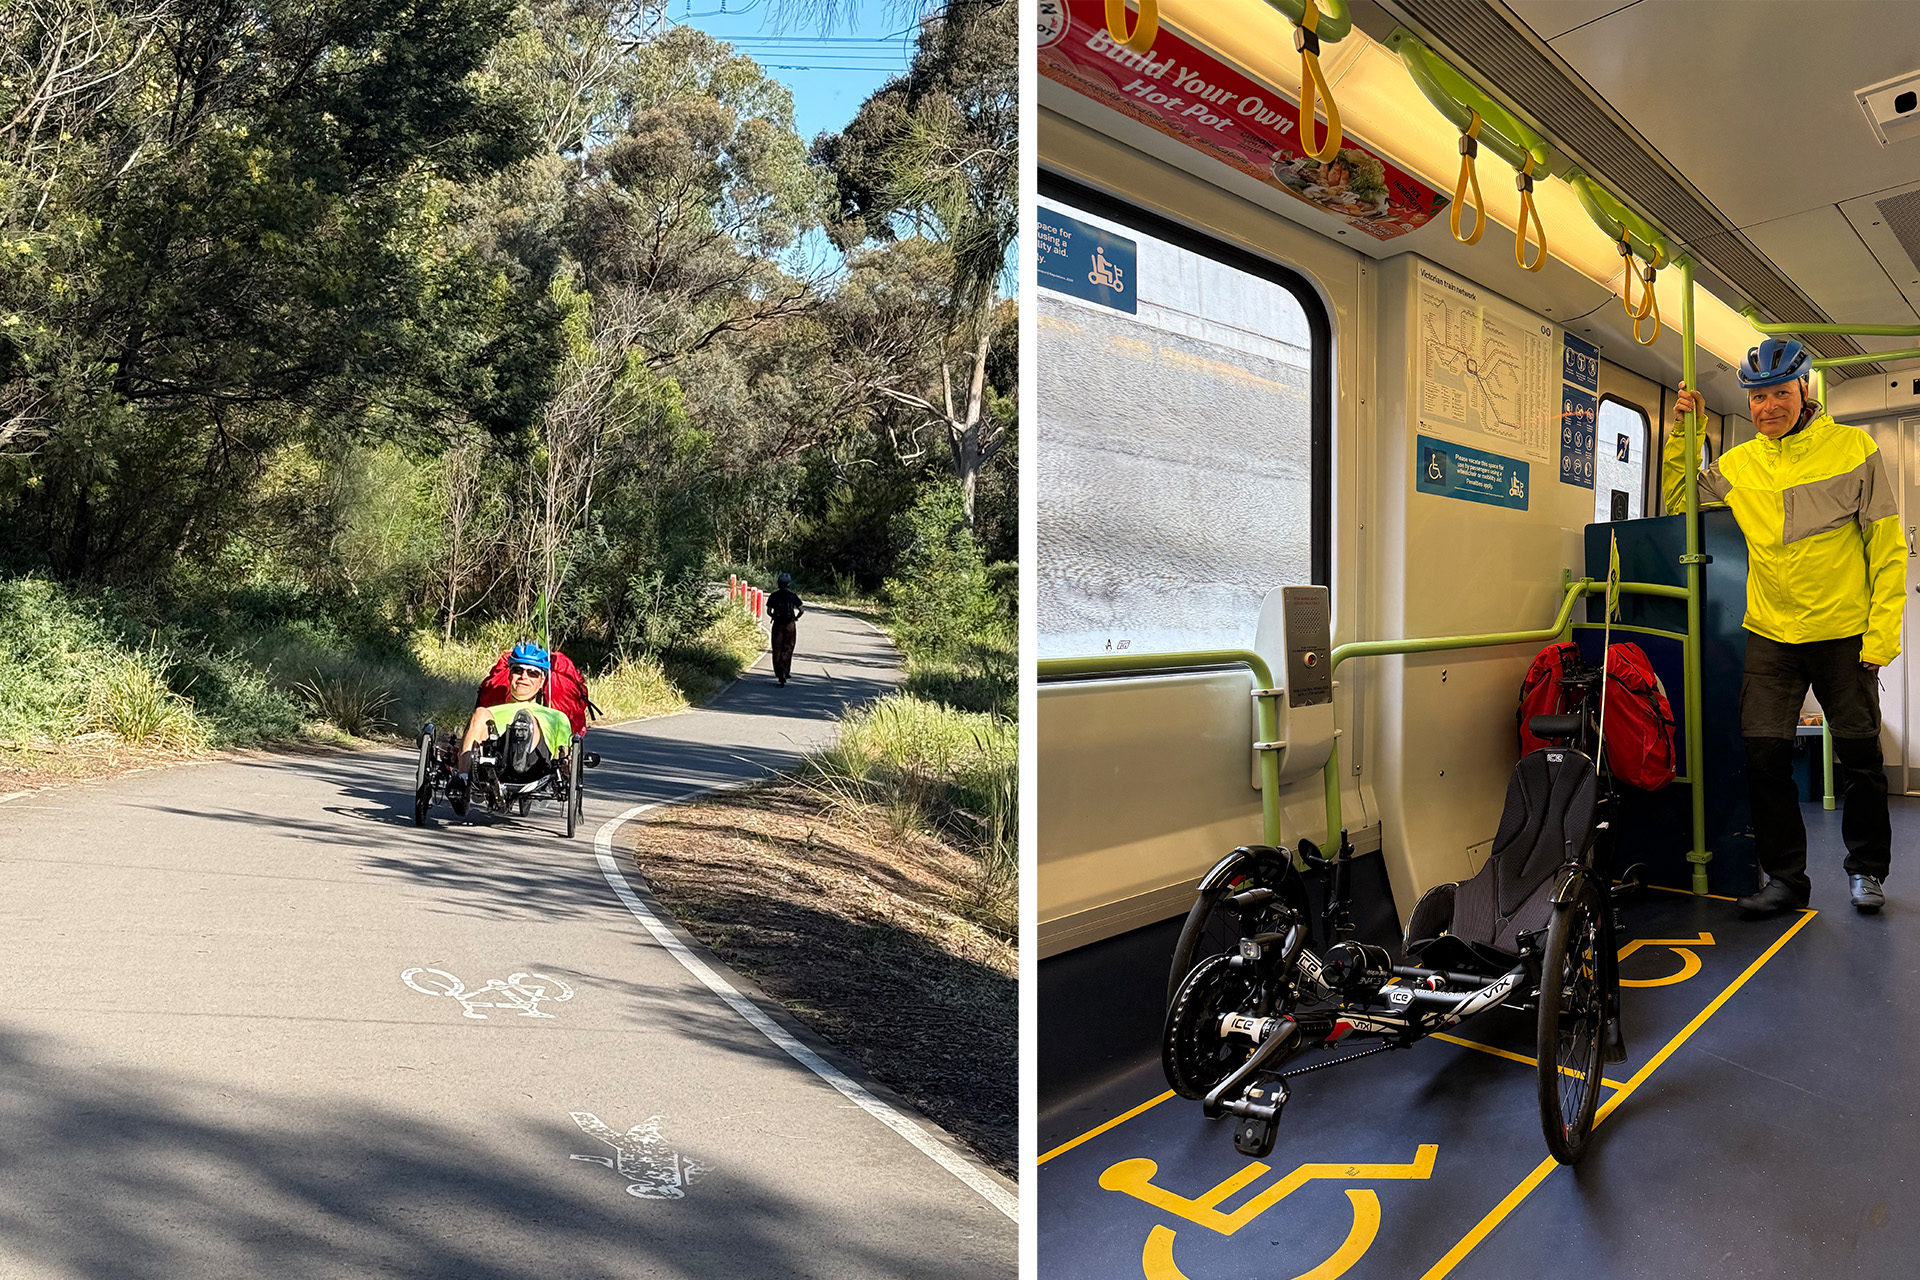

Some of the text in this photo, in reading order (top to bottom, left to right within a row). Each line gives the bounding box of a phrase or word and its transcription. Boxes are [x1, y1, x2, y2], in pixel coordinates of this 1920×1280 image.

[1086, 28, 1294, 134] Build Your Own
[1122, 79, 1234, 131] Hot Pot
[1393, 180, 1423, 212] INGREDIENTS
[1408, 185, 1421, 199] PICK
[1037, 222, 1072, 239] pace for
[1037, 232, 1068, 248] using a
[1053, 247, 1069, 258] aid.
[1420, 268, 1443, 286] Victorian
[1443, 280, 1456, 292] train
[1456, 287, 1477, 301] network
[1455, 453, 1468, 463] Please
[1483, 978, 1511, 999] VTX
[1231, 1018, 1254, 1031] ICE
[1352, 1020, 1370, 1031] VTX
